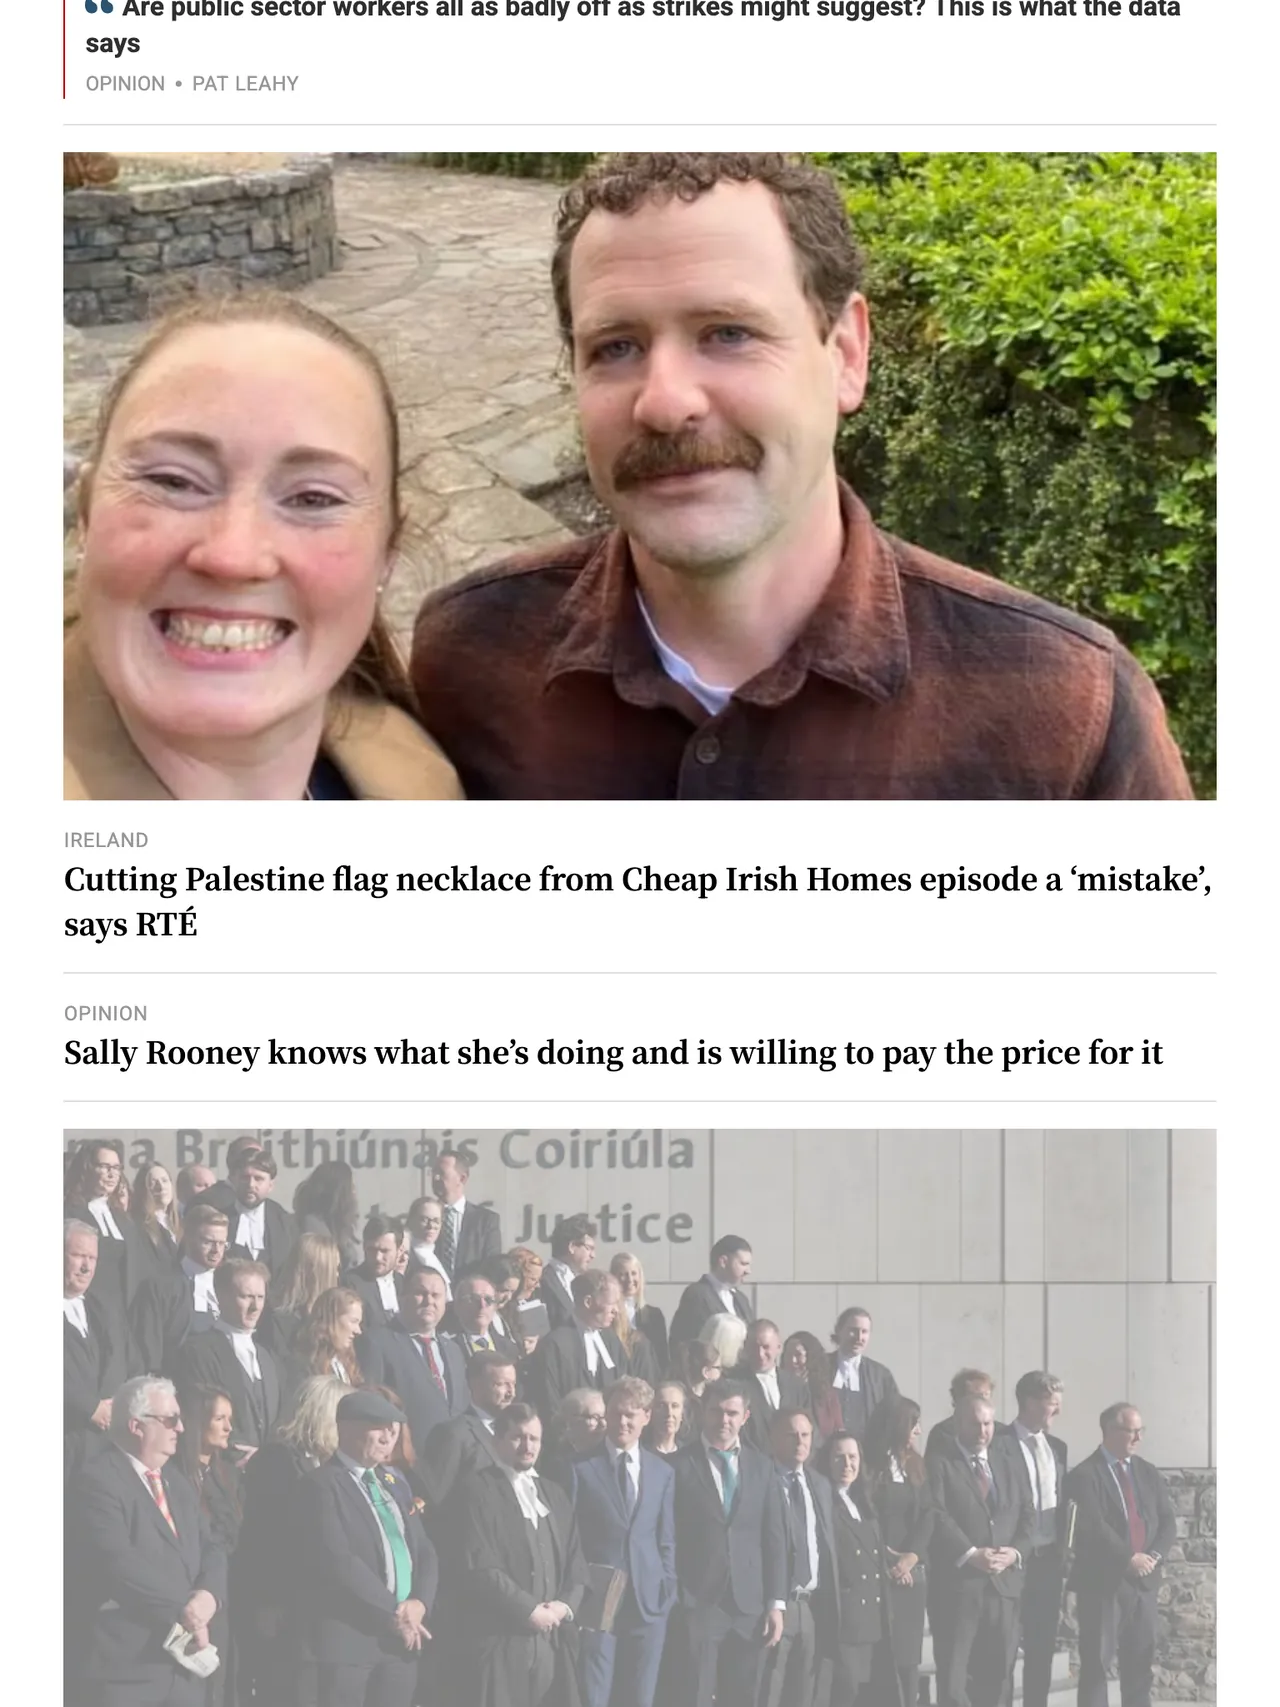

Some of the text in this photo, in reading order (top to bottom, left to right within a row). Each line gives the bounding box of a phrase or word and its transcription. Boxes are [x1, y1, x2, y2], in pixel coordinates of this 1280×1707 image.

[471, 1, 498, 16] as
[618, 0, 645, 16] as
[86, 37, 140, 58] says
[87, 76, 164, 91] OPINION
[194, 76, 298, 91] PAT LEAHY
[65, 832, 148, 847] IRELAND
[65, 866, 177, 899] Cutting
[186, 865, 324, 891] Palestine
[333, 865, 388, 898] flag
[396, 865, 531, 891] necklace
[539, 865, 614, 891] from
[623, 865, 717, 899] Cheap
[726, 865, 798, 891] Irish
[807, 867, 912, 891] Homes
[920, 865, 1037, 899] episode
[1046, 873, 1063, 891] a
[65, 905, 197, 944] says RTÉ
[65, 1006, 146, 1021] OPINION
[65, 1038, 138, 1072] Sally
[146, 1041, 260, 1072] Rooney
[268, 1038, 366, 1065] knows
[374, 1038, 450, 1065] what
[537, 1038, 624, 1072] doing
[632, 1038, 689, 1065] and
[697, 1039, 722, 1065] is
[729, 1038, 837, 1072] willing
[844, 1042, 874, 1065] to
[883, 1046, 937, 1072] pay
[944, 1038, 993, 1065] the
[1001, 1039, 1080, 1072] price
[1088, 1038, 1134, 1065] for
[1141, 1039, 1164, 1065] it
[500, 1129, 694, 1169] Coiriúla
[514, 1202, 693, 1244] Jutice
